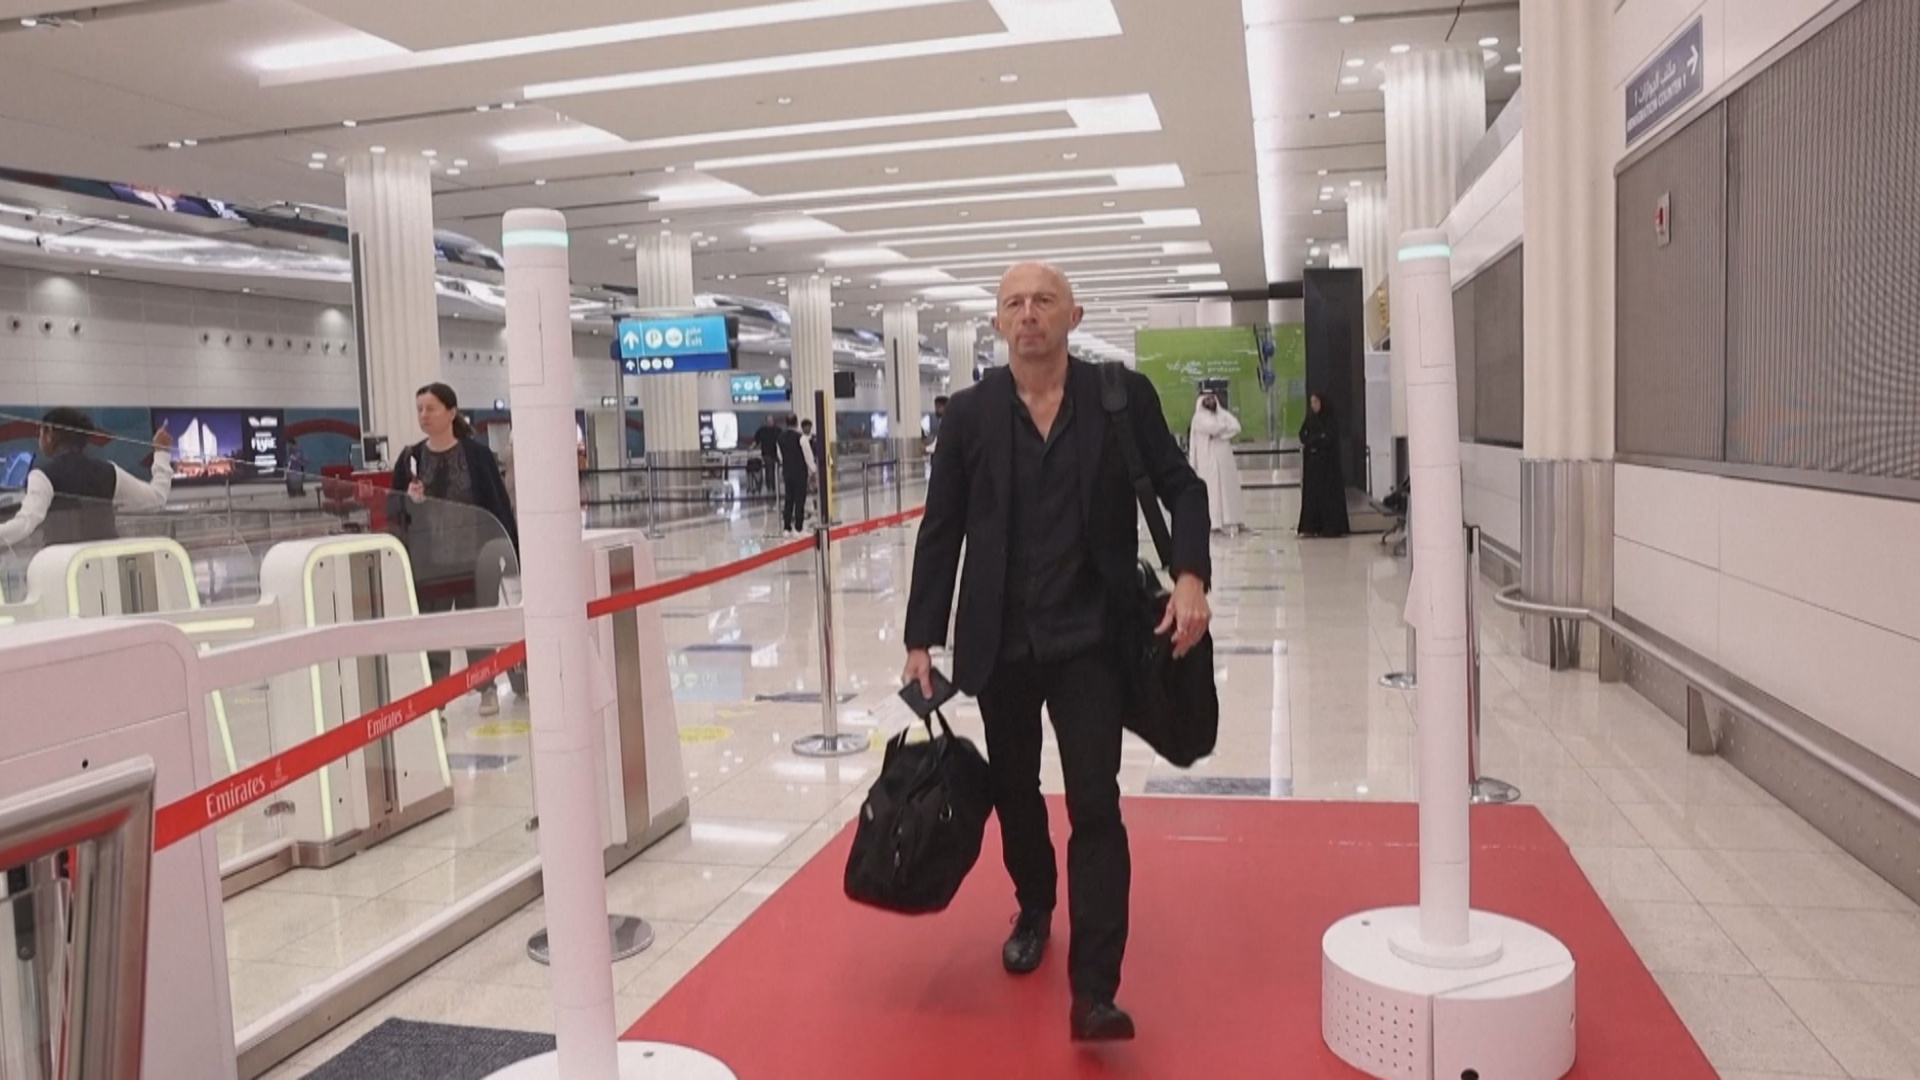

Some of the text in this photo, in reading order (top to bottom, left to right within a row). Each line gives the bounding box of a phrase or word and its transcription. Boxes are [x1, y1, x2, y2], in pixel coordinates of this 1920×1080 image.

[1658, 76, 1682, 108] COUNTER
[367, 709, 403, 740] Emirates
[206, 774, 266, 819] Emirates
